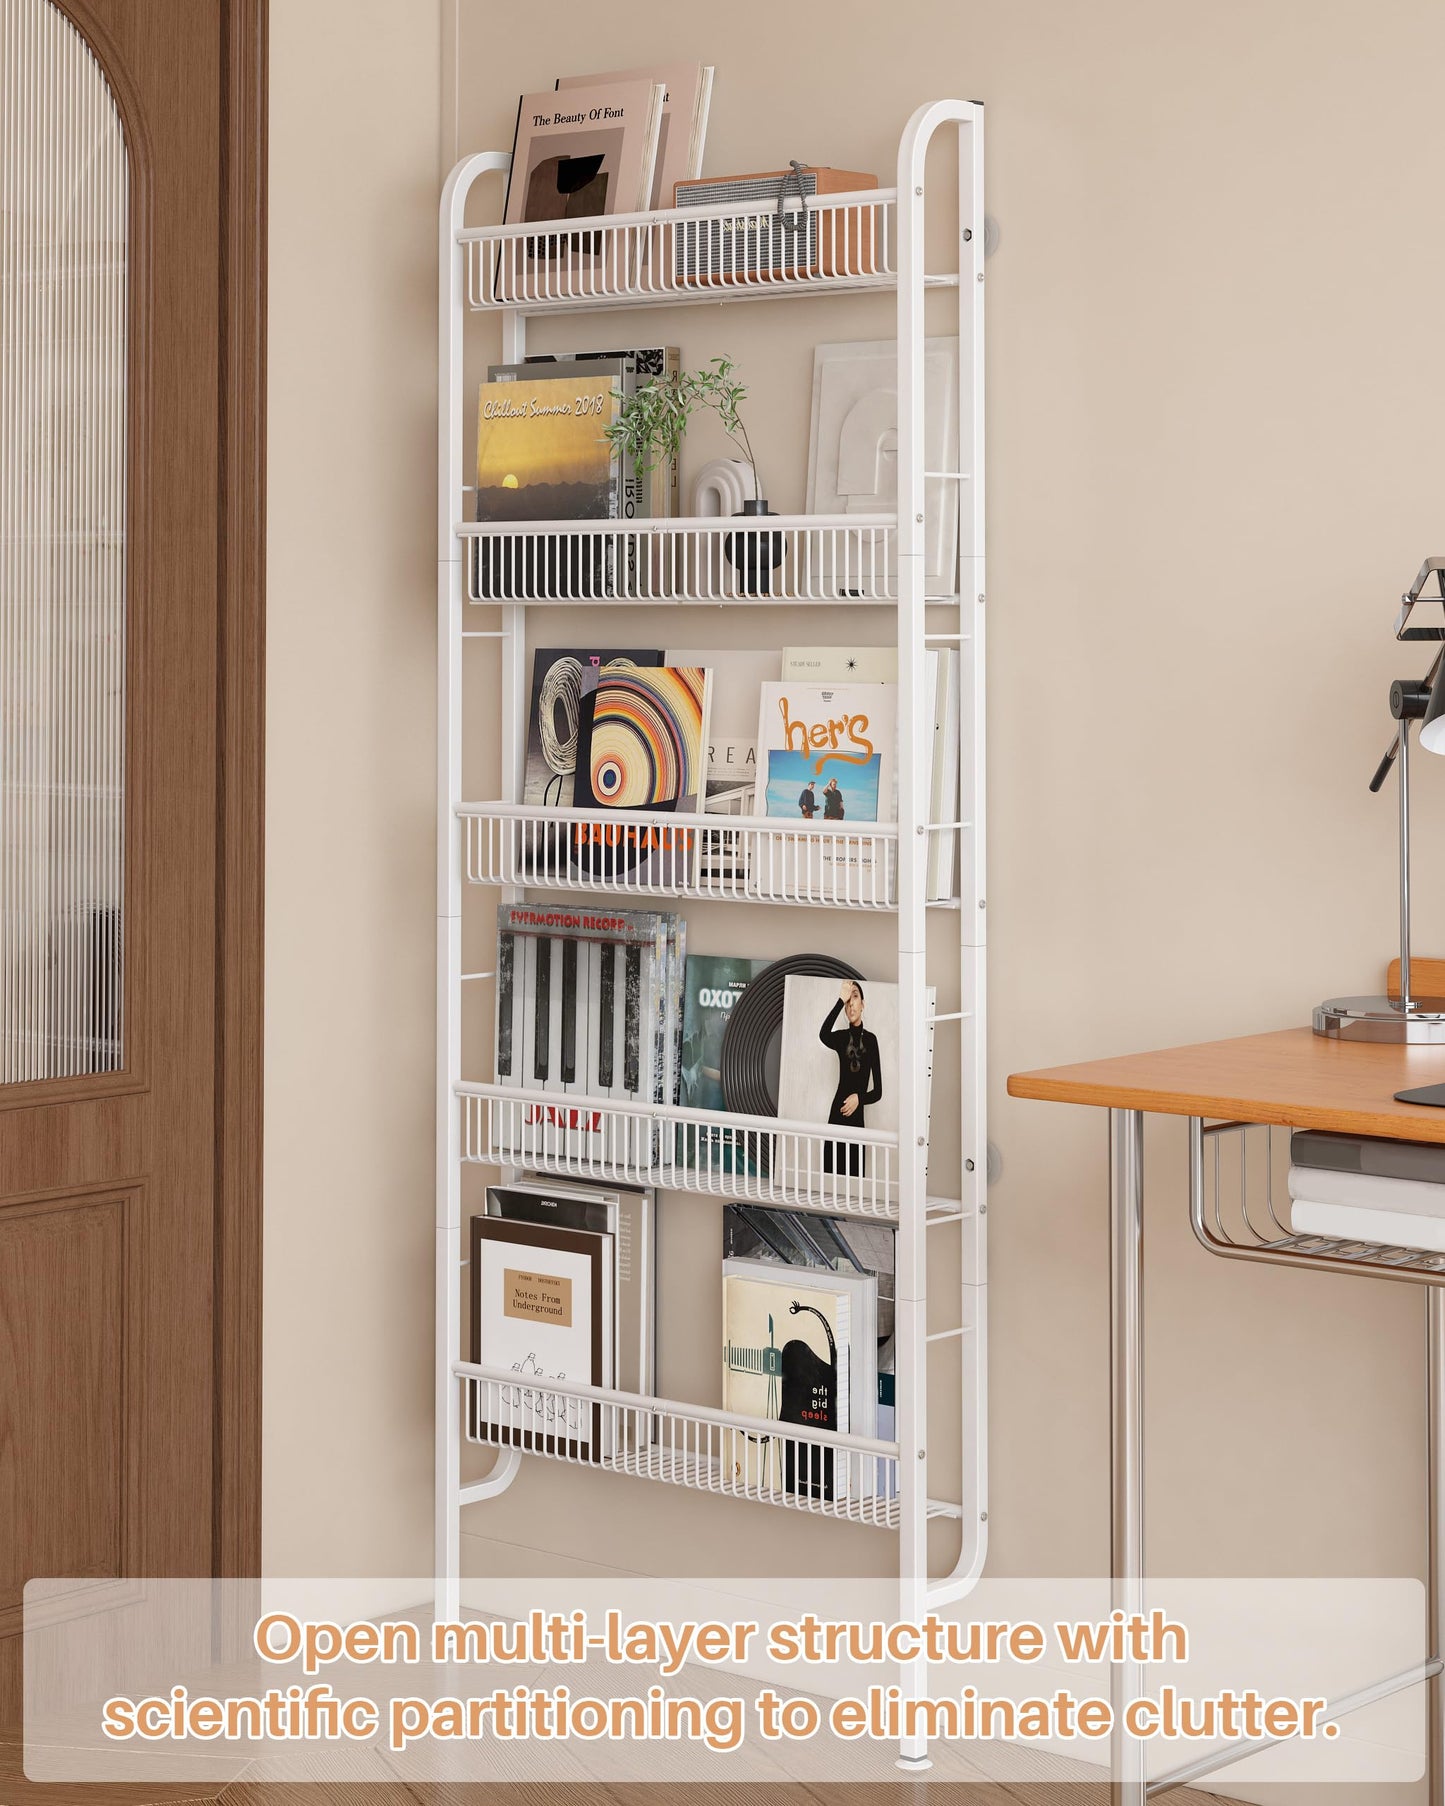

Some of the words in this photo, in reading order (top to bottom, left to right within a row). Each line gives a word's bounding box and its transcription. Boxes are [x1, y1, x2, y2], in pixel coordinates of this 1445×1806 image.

[533, 115, 551, 127] The
[554, 112, 586, 125] Beauty
[589, 108, 602, 120] Of
[604, 107, 624, 119] Font
[483, 399, 528, 420] Chillout
[530, 396, 573, 417] Summer
[574, 394, 604, 416] 2018
[779, 697, 874, 776] her's
[574, 822, 694, 852] BAUHAUS
[512, 1299, 563, 1316] Underground
[514, 1288, 538, 1301] Notes
[541, 1292, 561, 1305] From
